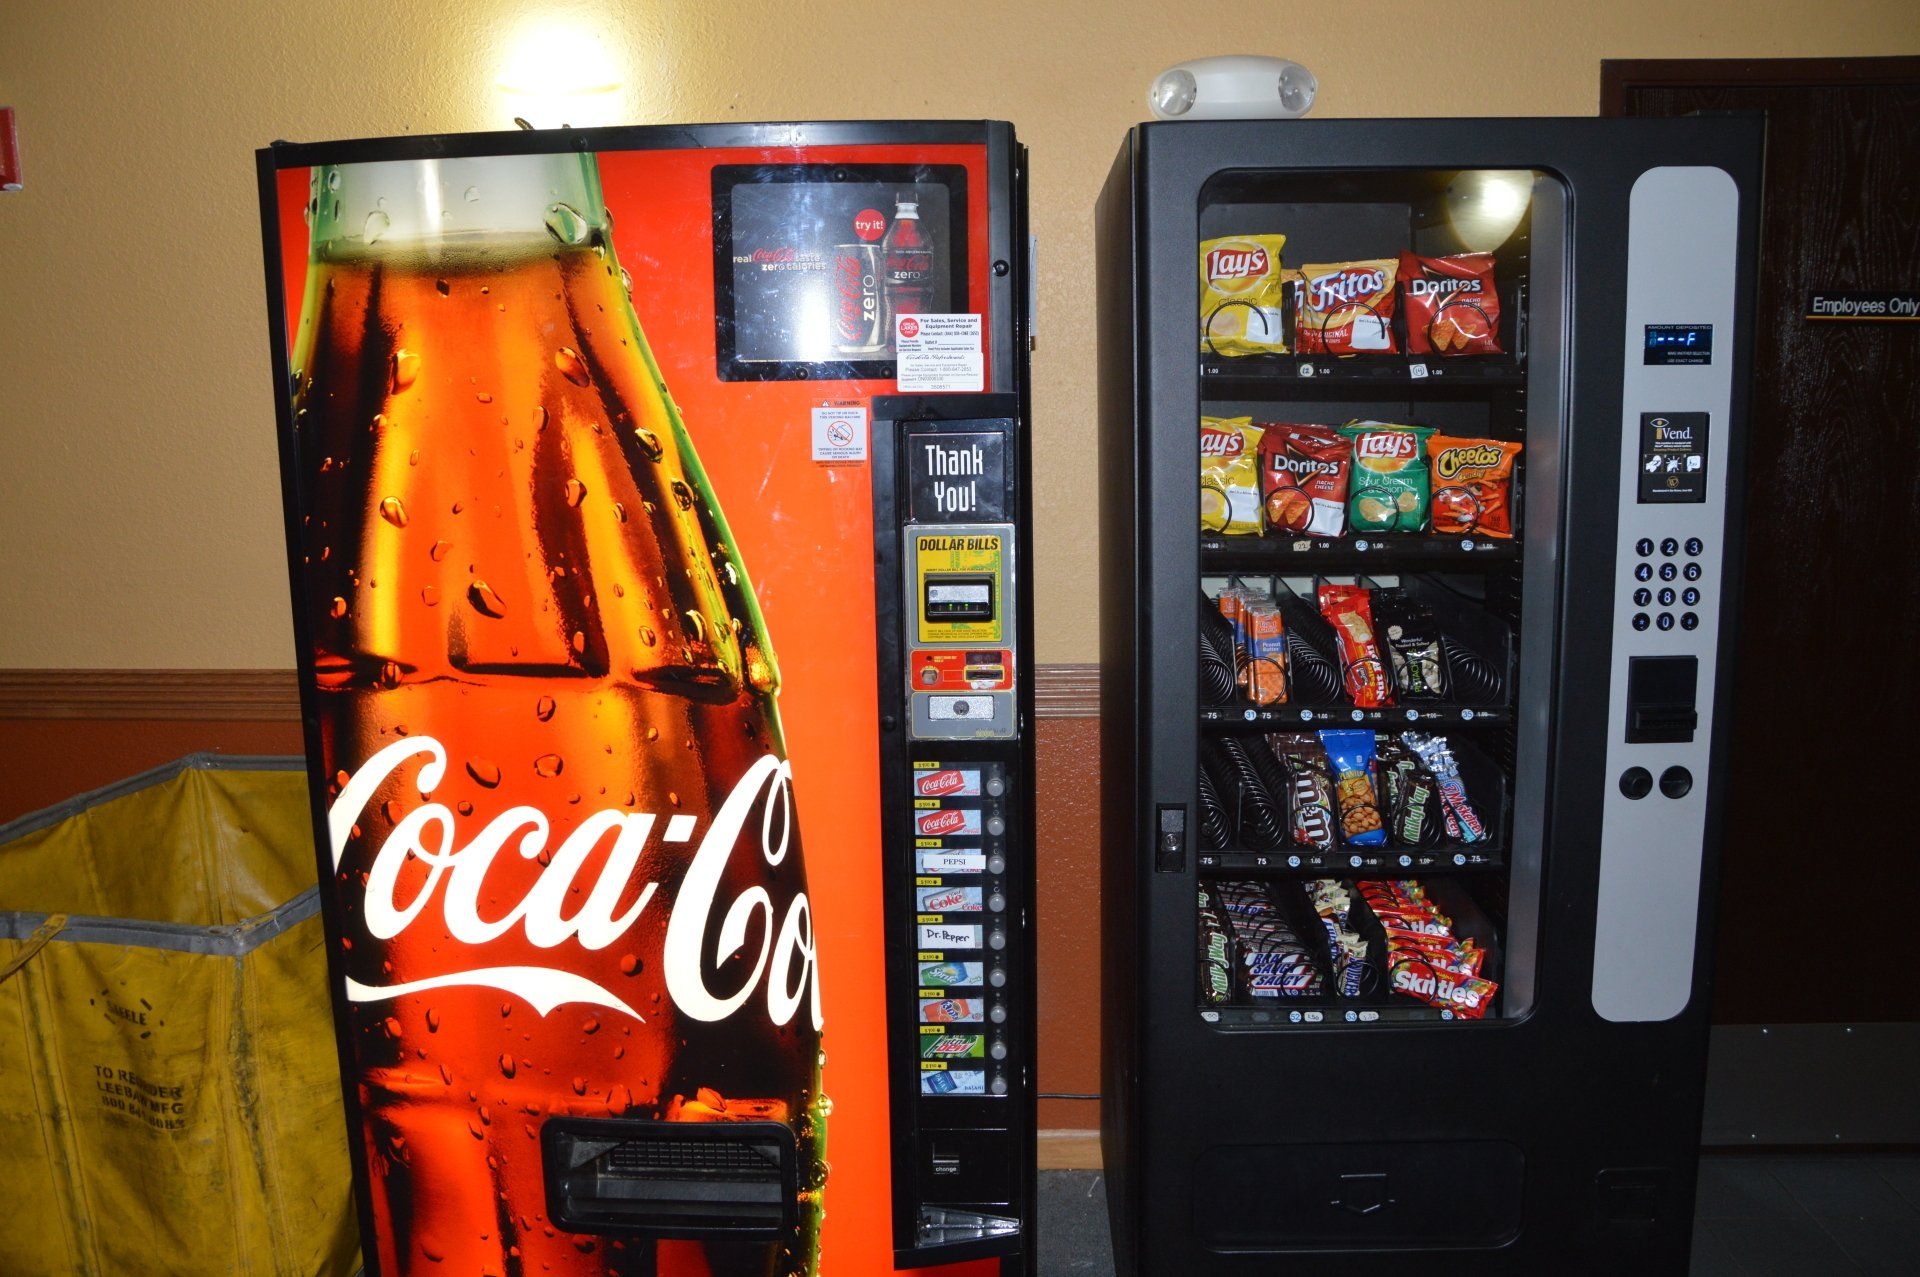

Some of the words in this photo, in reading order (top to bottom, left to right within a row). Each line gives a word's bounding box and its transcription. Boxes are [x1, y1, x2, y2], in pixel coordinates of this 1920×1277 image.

[855, 220, 871, 231] try
[872, 220, 884, 230] it!
[733, 253, 752, 263] real
[761, 263, 786, 271] zero
[786, 262, 827, 271] calories
[1210, 250, 1265, 280] Lay's
[894, 271, 921, 279] zero
[1310, 272, 1384, 312] Fritos
[1412, 279, 1481, 295] Doritos
[863, 275, 875, 321] zero
[1813, 297, 1886, 316] Employees
[1889, 297, 1920, 317] Only
[1360, 433, 1414, 458] Lay's
[925, 444, 984, 475] Thank
[1274, 454, 1339, 475] Doritos
[1439, 446, 1500, 477] Cheetos
[1358, 476, 1380, 486] Sour
[1382, 476, 1413, 485] Cream
[934, 480, 976, 512] You!
[919, 538, 965, 551] DOLLAR
[966, 537, 999, 550] BILLS
[1357, 541, 1367, 549] 23
[1462, 541, 1473, 549] 25
[1642, 541, 1649, 554] 1
[1666, 541, 1674, 553] 2
[1690, 541, 1698, 553] 3
[1640, 566, 1648, 578] 4
[1664, 566, 1672, 578] 5
[1688, 566, 1697, 578] 6
[1640, 592, 1647, 604] 7
[1664, 591, 1671, 603] 8
[1687, 591, 1695, 603] 9
[1662, 616, 1669, 628] 0
[1245, 711, 1256, 719] 31
[1301, 711, 1312, 719] 32
[921, 772, 958, 794] Coca-Cola
[922, 811, 959, 833] Coca-Cola
[1403, 804, 1426, 843] Milky
[1289, 857, 1299, 865] 42
[1400, 857, 1411, 865] 44
[929, 894, 962, 911] Coke
[961, 903, 983, 911] Coke
[926, 928, 941, 938] Dr.
[942, 930, 970, 944] Pepper
[929, 967, 957, 983] Sprite
[1256, 975, 1305, 986] SAUCY
[1346, 1012, 1356, 1020] 53
[1442, 1011, 1452, 1019] 55
[94, 1064, 114, 1080] TO
[935, 1166, 957, 1174] change
